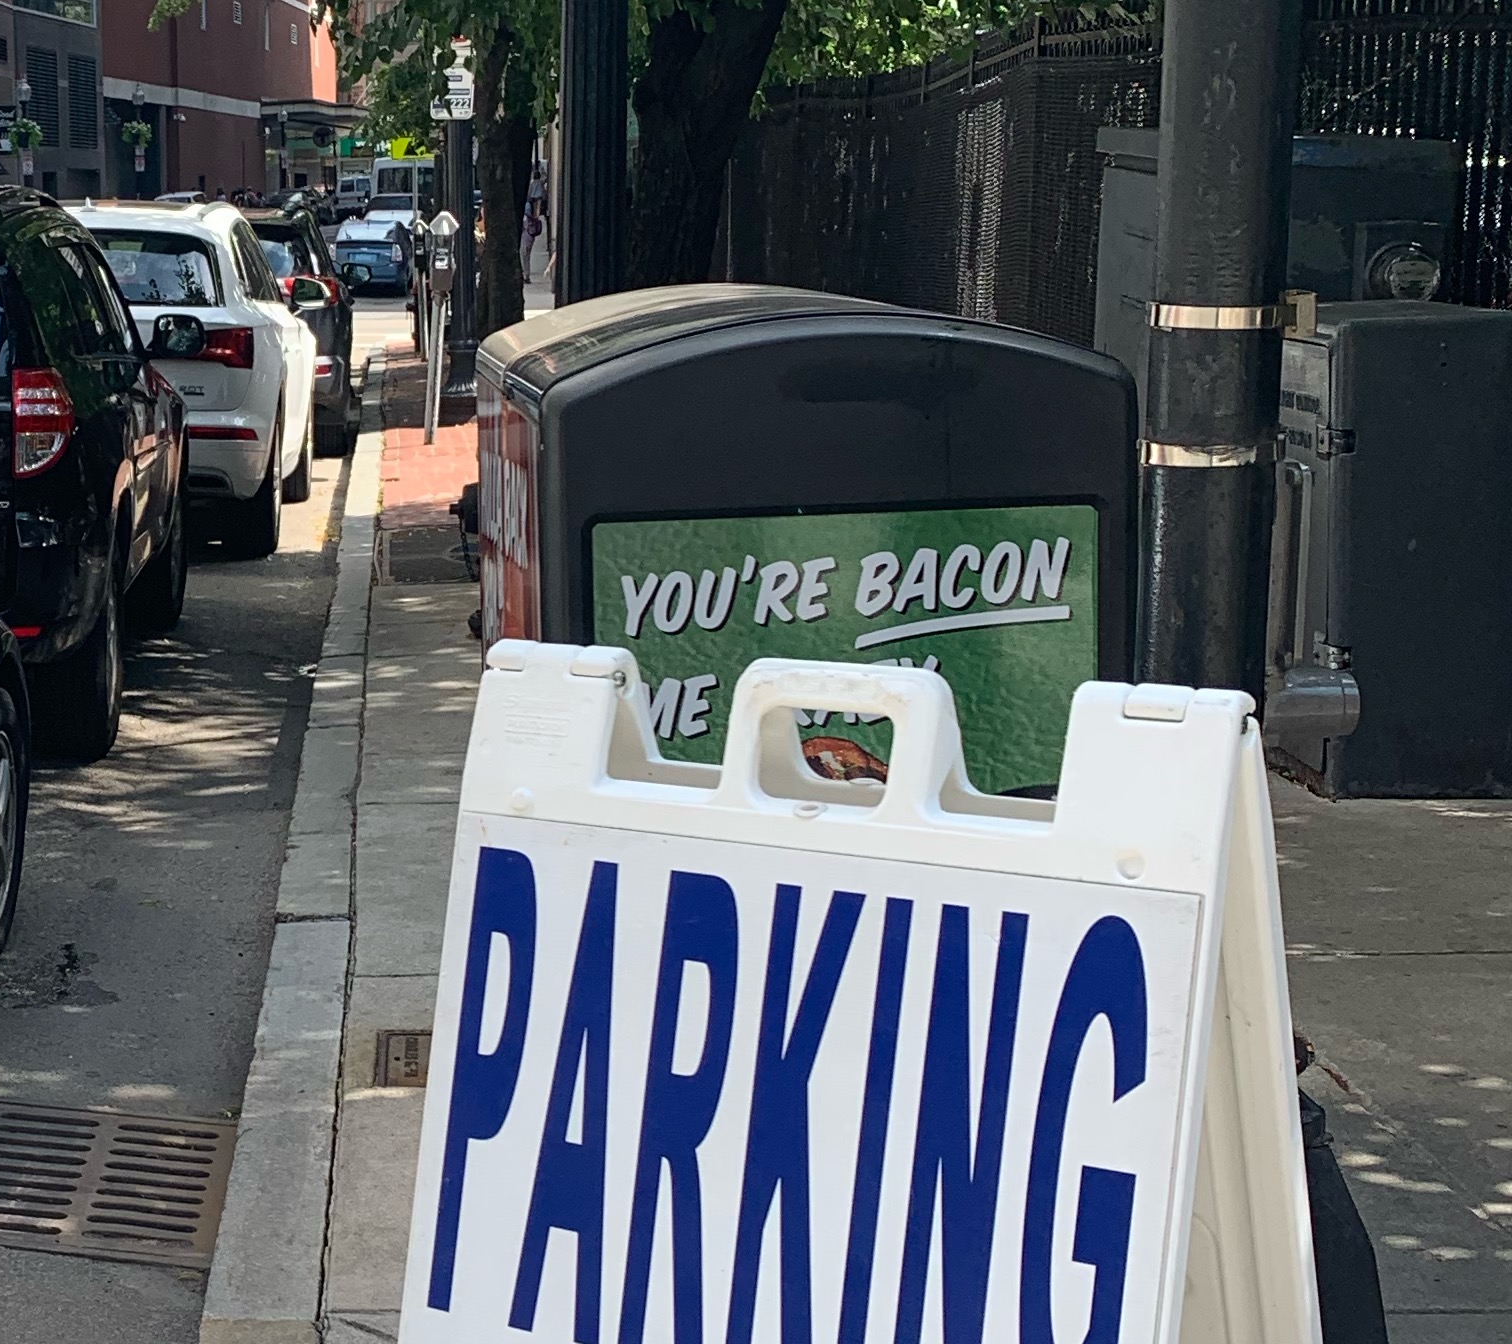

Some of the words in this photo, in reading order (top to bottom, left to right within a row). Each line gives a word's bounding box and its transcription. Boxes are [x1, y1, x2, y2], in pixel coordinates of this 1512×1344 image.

[621, 555, 836, 639] YOU'RE
[854, 535, 1070, 618] BACON
[640, 673, 718, 740] ME
